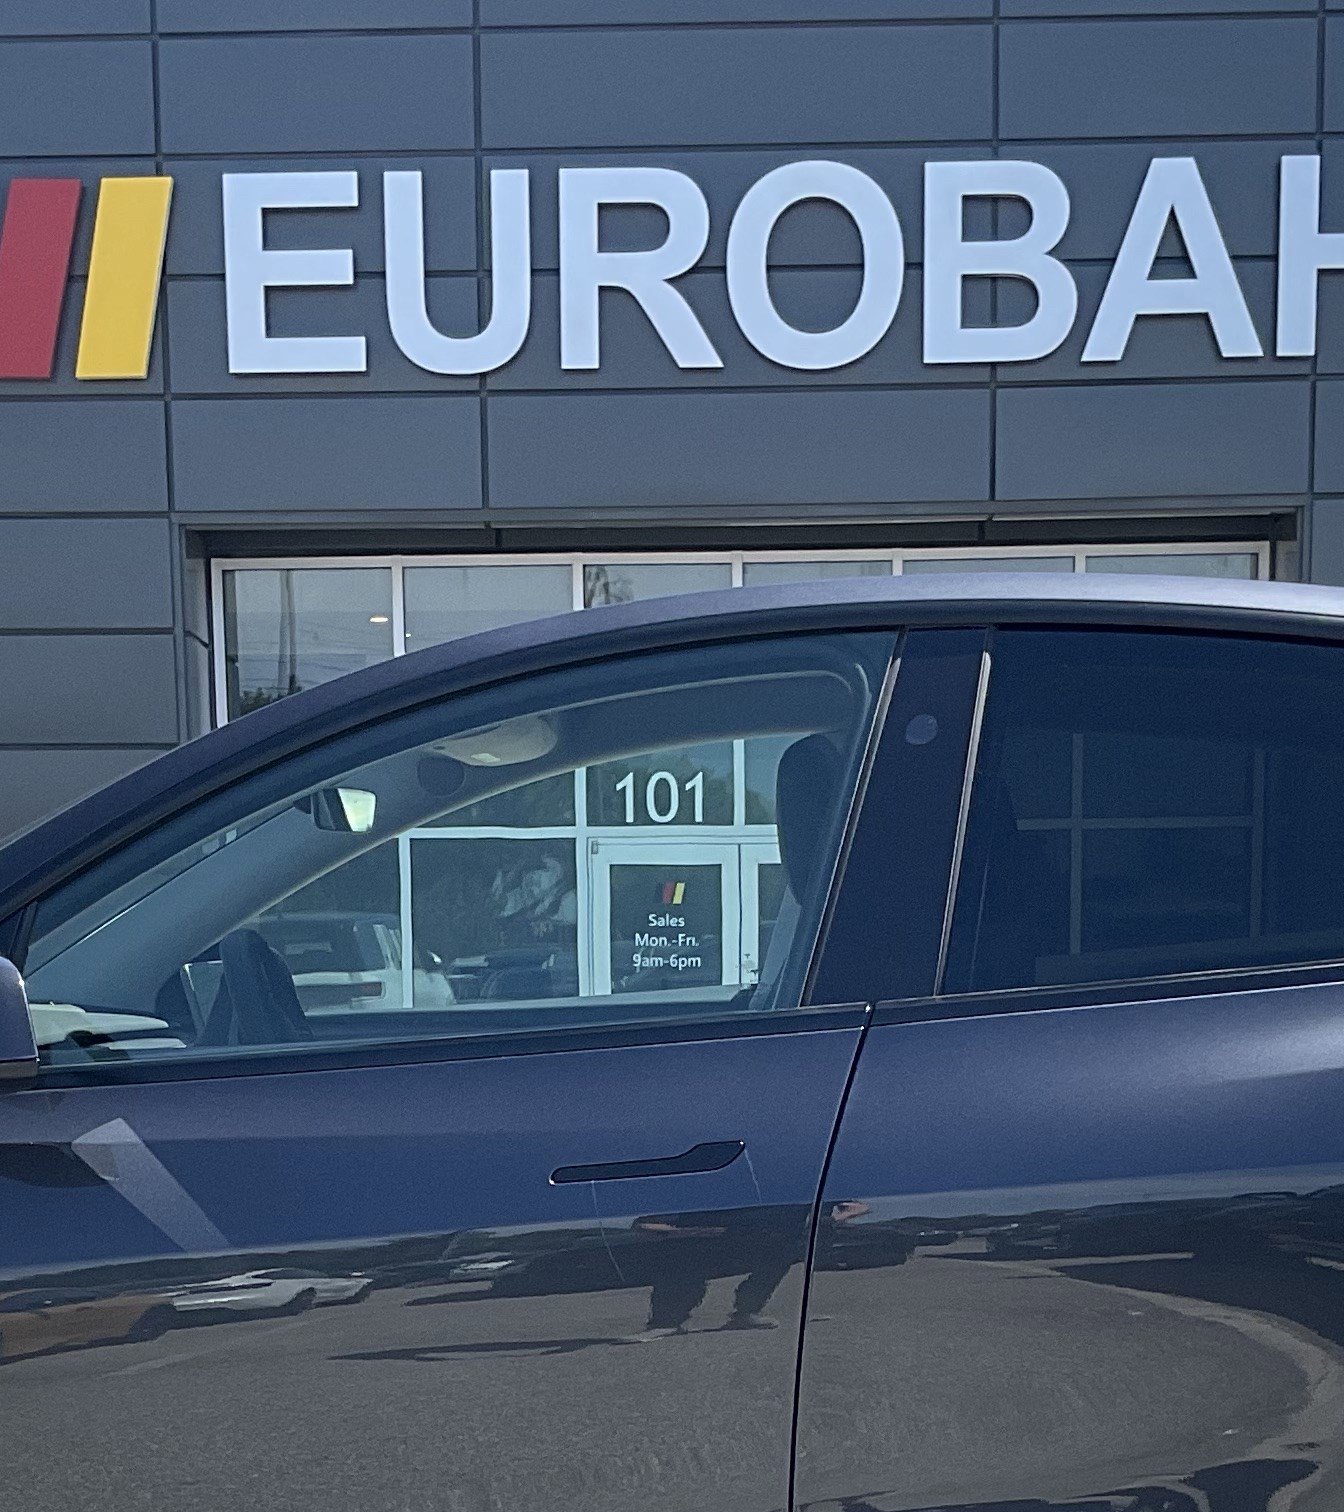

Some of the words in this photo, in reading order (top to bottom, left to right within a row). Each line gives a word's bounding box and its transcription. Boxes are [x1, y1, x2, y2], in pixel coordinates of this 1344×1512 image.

[615, 771, 704, 823] 101
[648, 912, 686, 928] Sales
[634, 932, 701, 948] Mon.-Fri.
[632, 953, 702, 971] 9am-6pm
